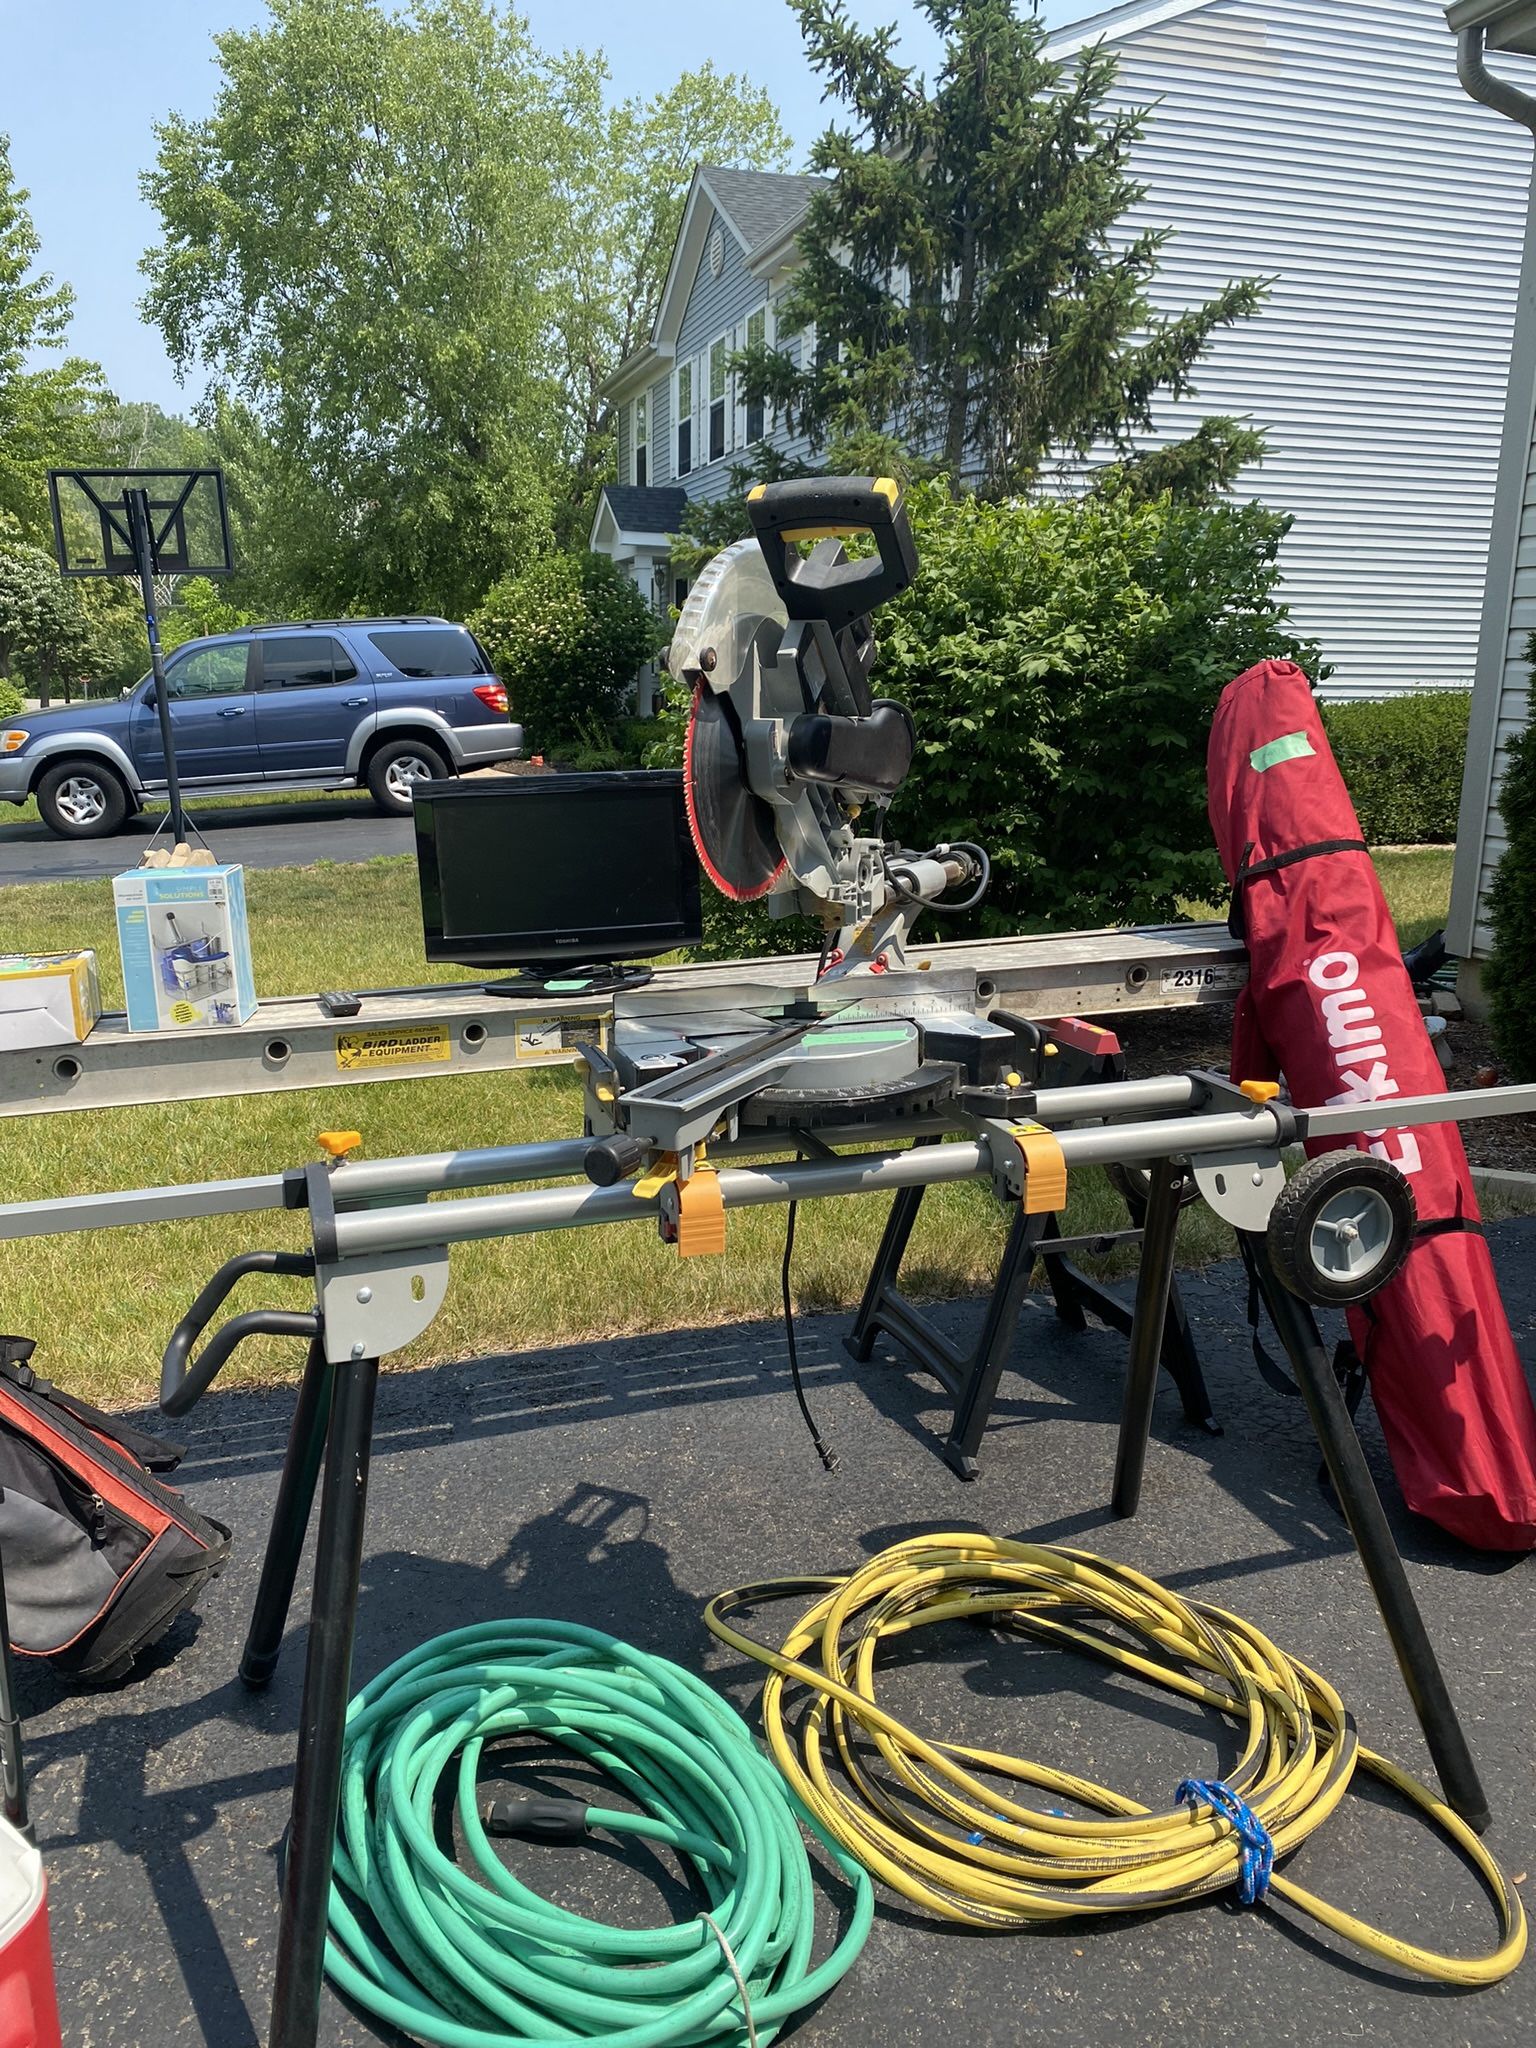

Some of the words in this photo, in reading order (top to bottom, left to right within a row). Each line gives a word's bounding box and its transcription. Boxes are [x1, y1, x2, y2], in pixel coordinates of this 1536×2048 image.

[1174, 968, 1214, 987] 2316
[399, 1036, 441, 1046] LADDER
[369, 1045, 431, 1057] EQUIPMENT
